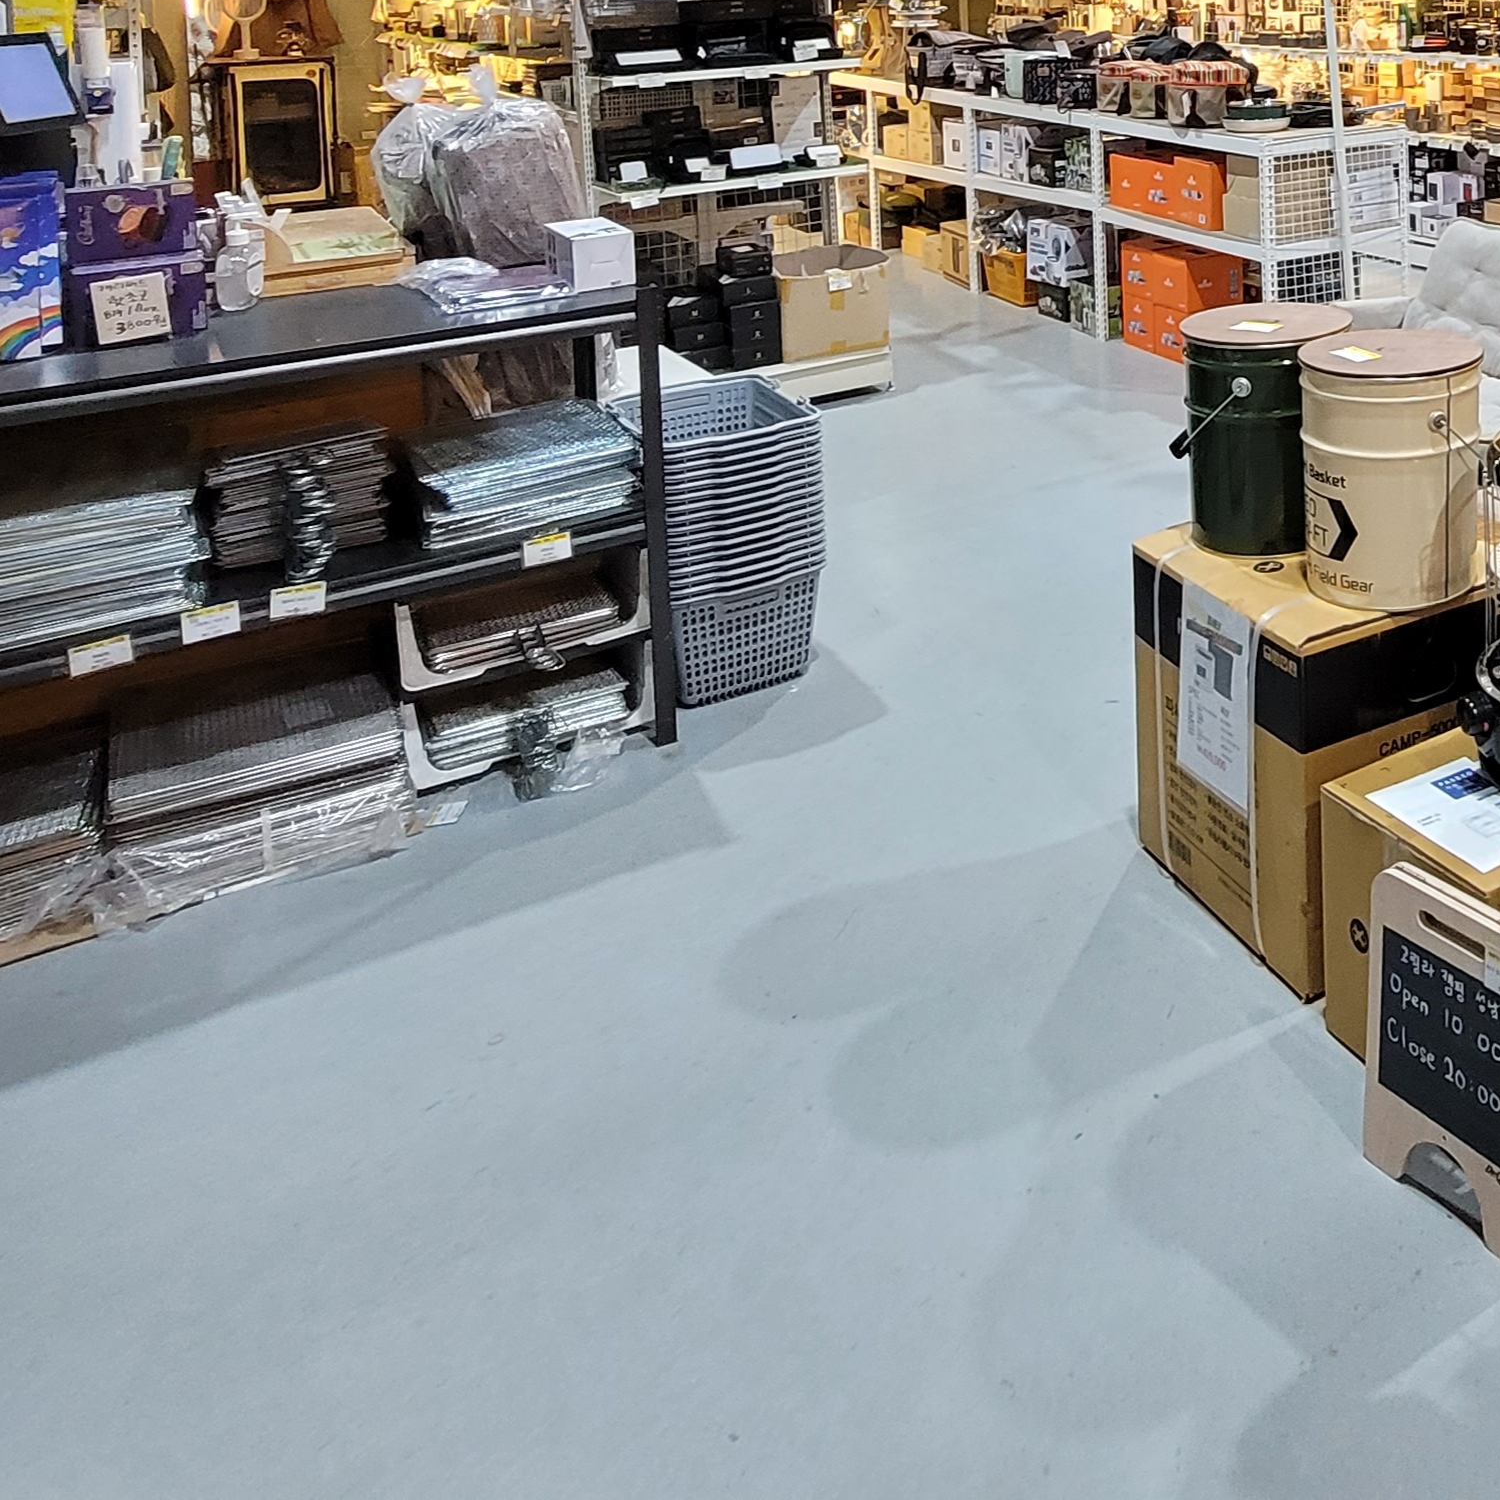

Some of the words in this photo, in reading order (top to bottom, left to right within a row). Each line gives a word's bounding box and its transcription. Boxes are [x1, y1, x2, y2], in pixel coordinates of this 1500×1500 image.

[1309, 463, 1347, 489] Basket
[1340, 574, 1375, 594] Gear
[1390, 972, 1429, 1016] Open
[1387, 1017, 1436, 1070] Close
